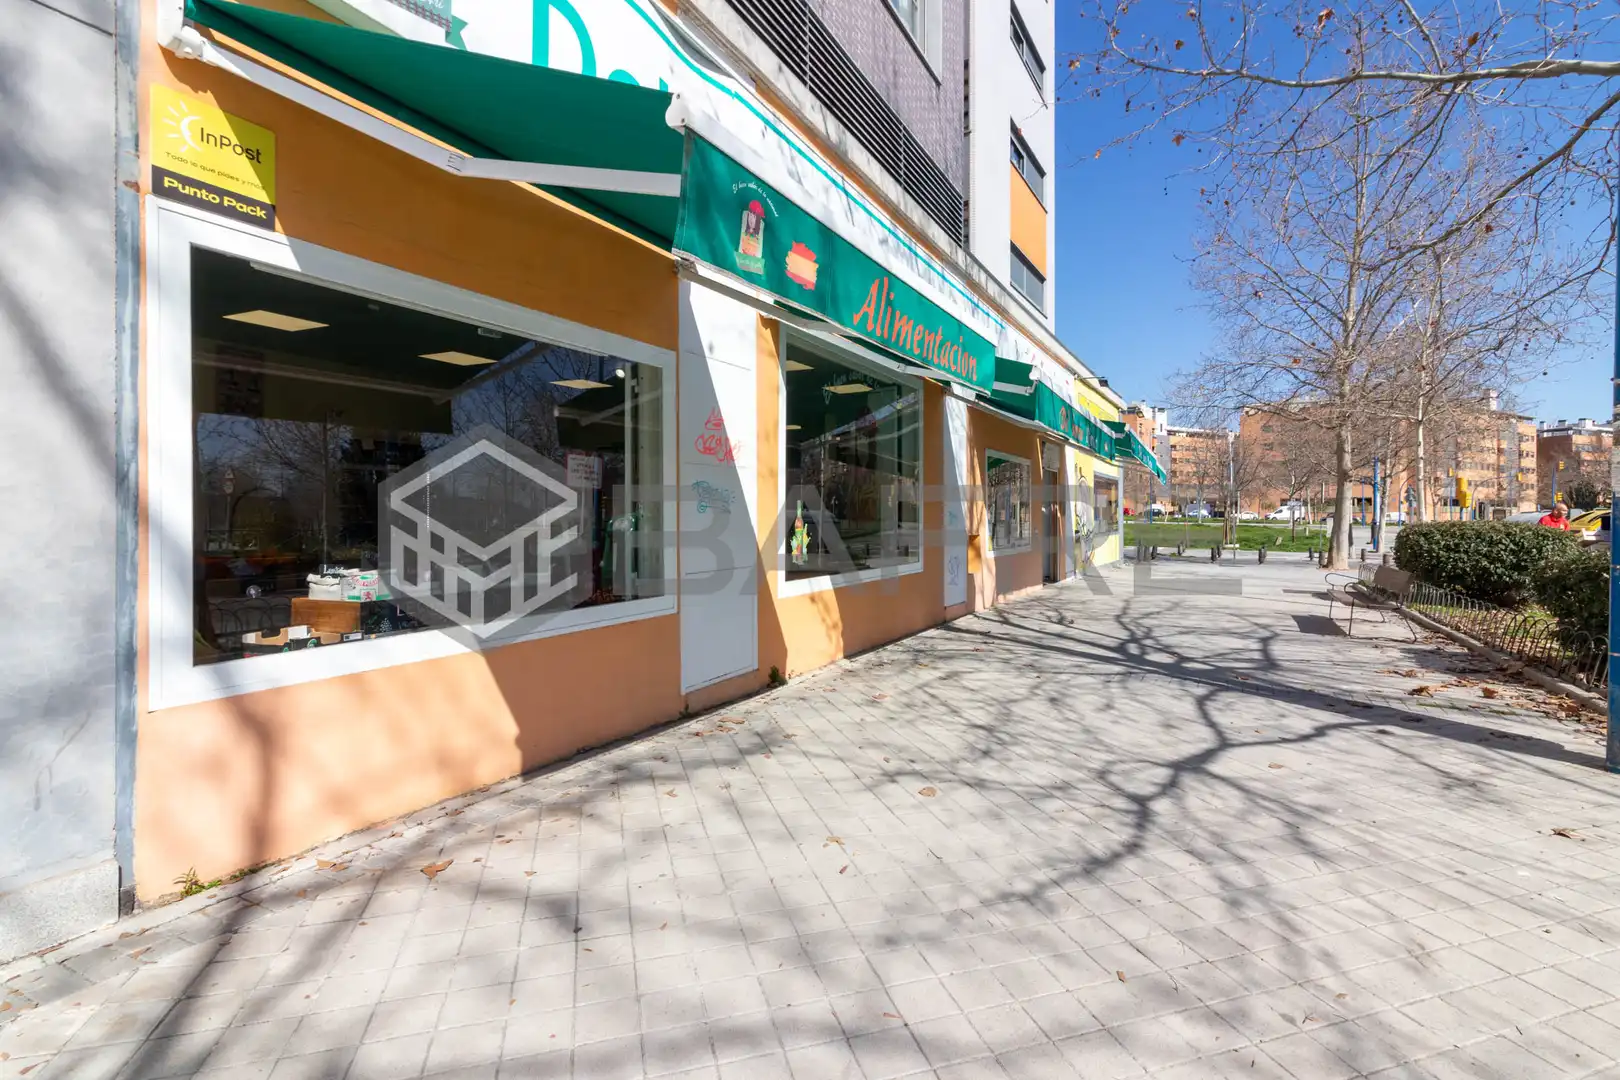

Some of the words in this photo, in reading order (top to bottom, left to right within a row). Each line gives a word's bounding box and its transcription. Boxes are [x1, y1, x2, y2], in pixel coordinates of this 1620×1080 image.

[165, 151, 188, 164] Todo
[199, 164, 216, 174] que
[200, 127, 262, 164] InPost
[163, 176, 220, 204] Punto
[223, 196, 267, 219] Pack
[853, 276, 977, 382] Alimentacion
